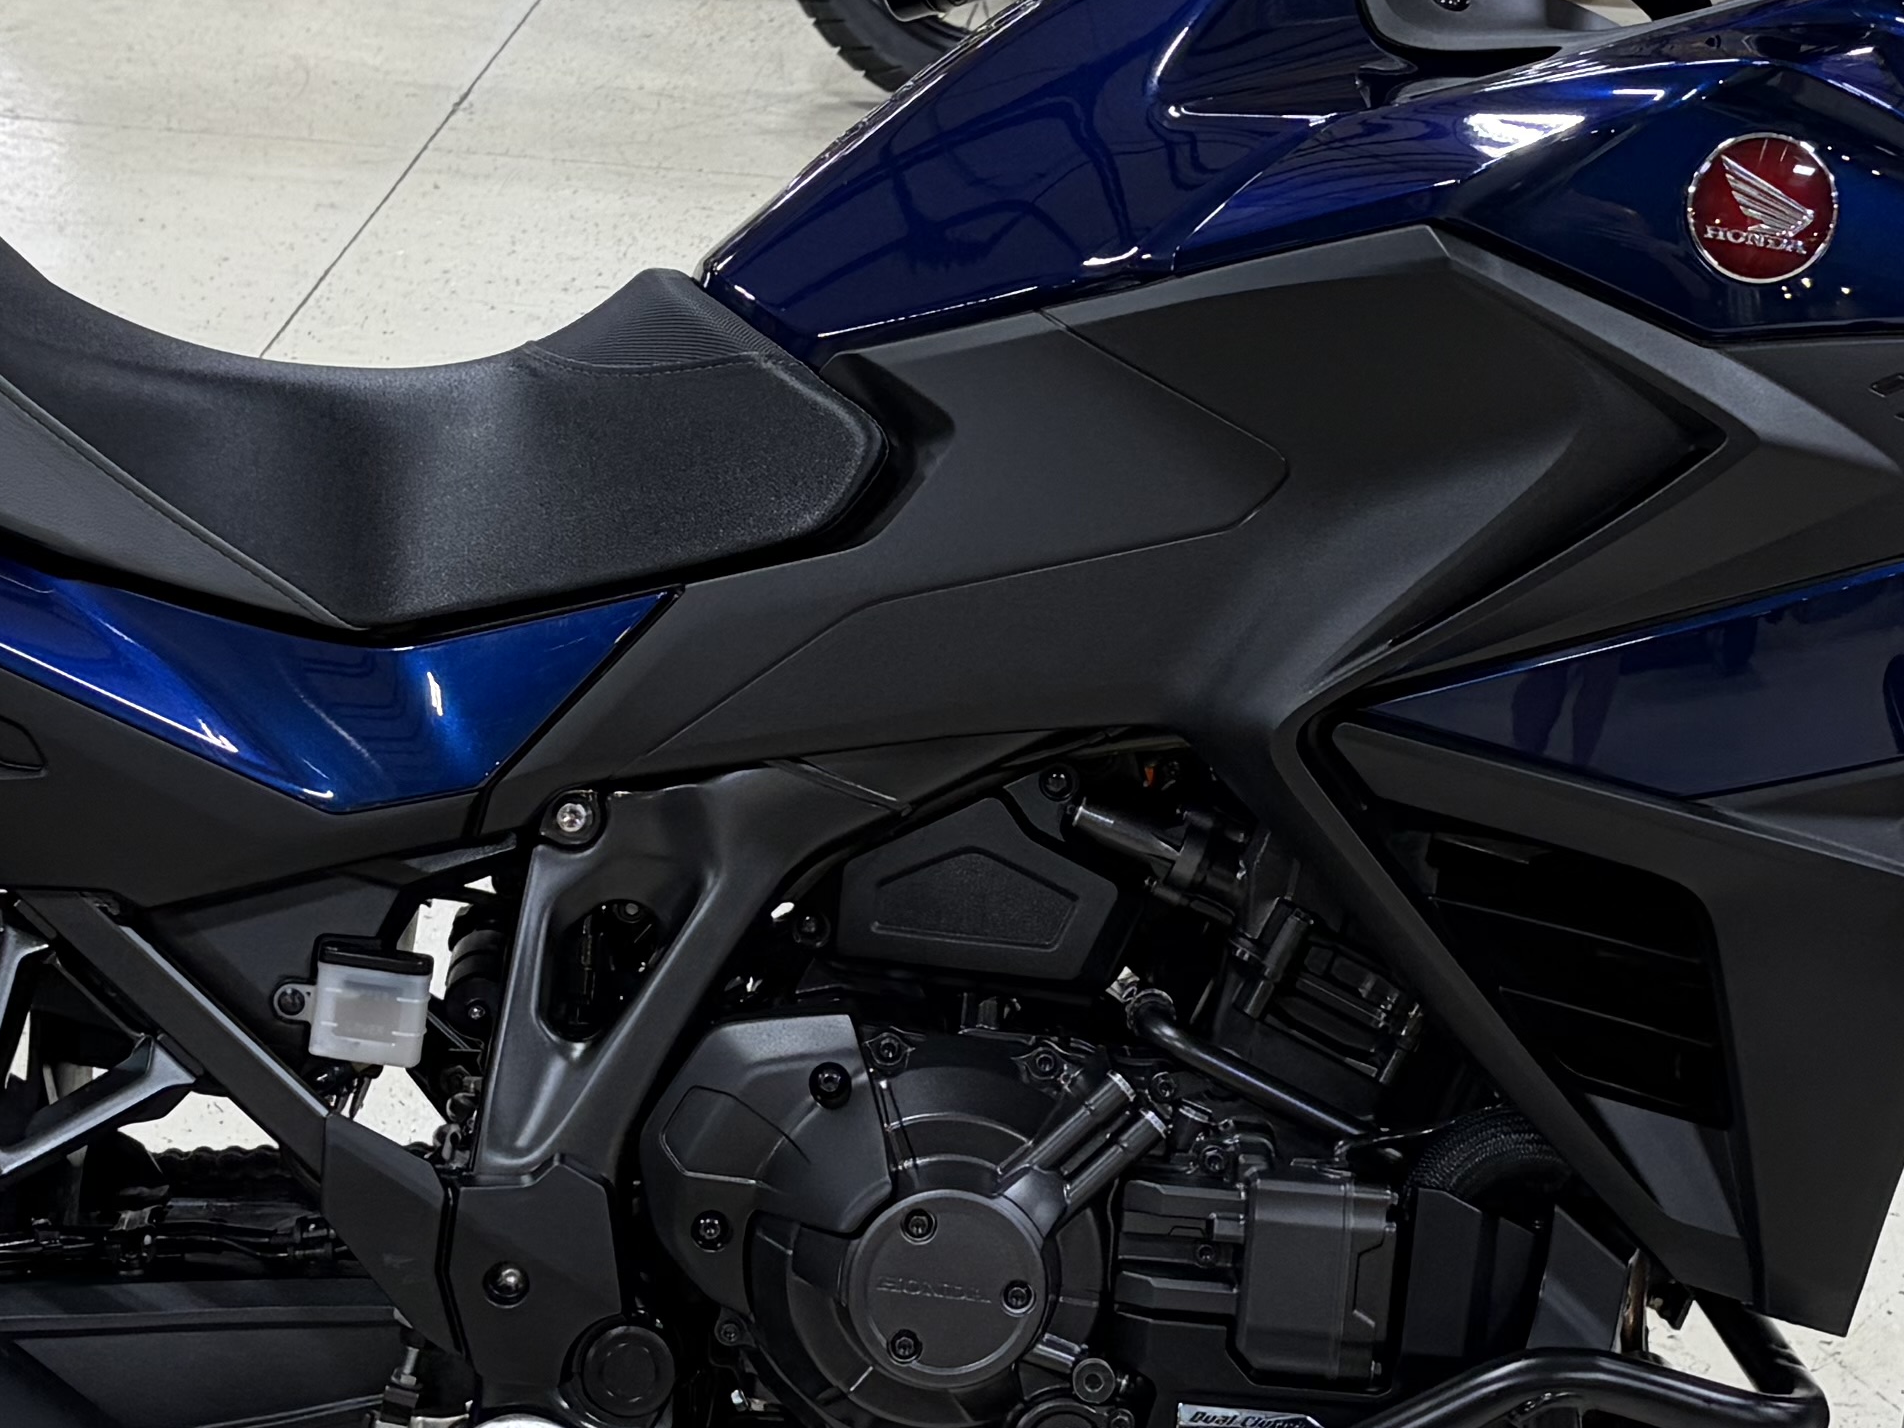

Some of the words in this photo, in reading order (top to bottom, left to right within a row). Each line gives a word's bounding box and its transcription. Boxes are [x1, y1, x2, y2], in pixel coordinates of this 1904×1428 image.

[1703, 224, 1807, 255] HONDA
[875, 1276, 992, 1304] HONDA
[1189, 1410, 1238, 1426] Dual
